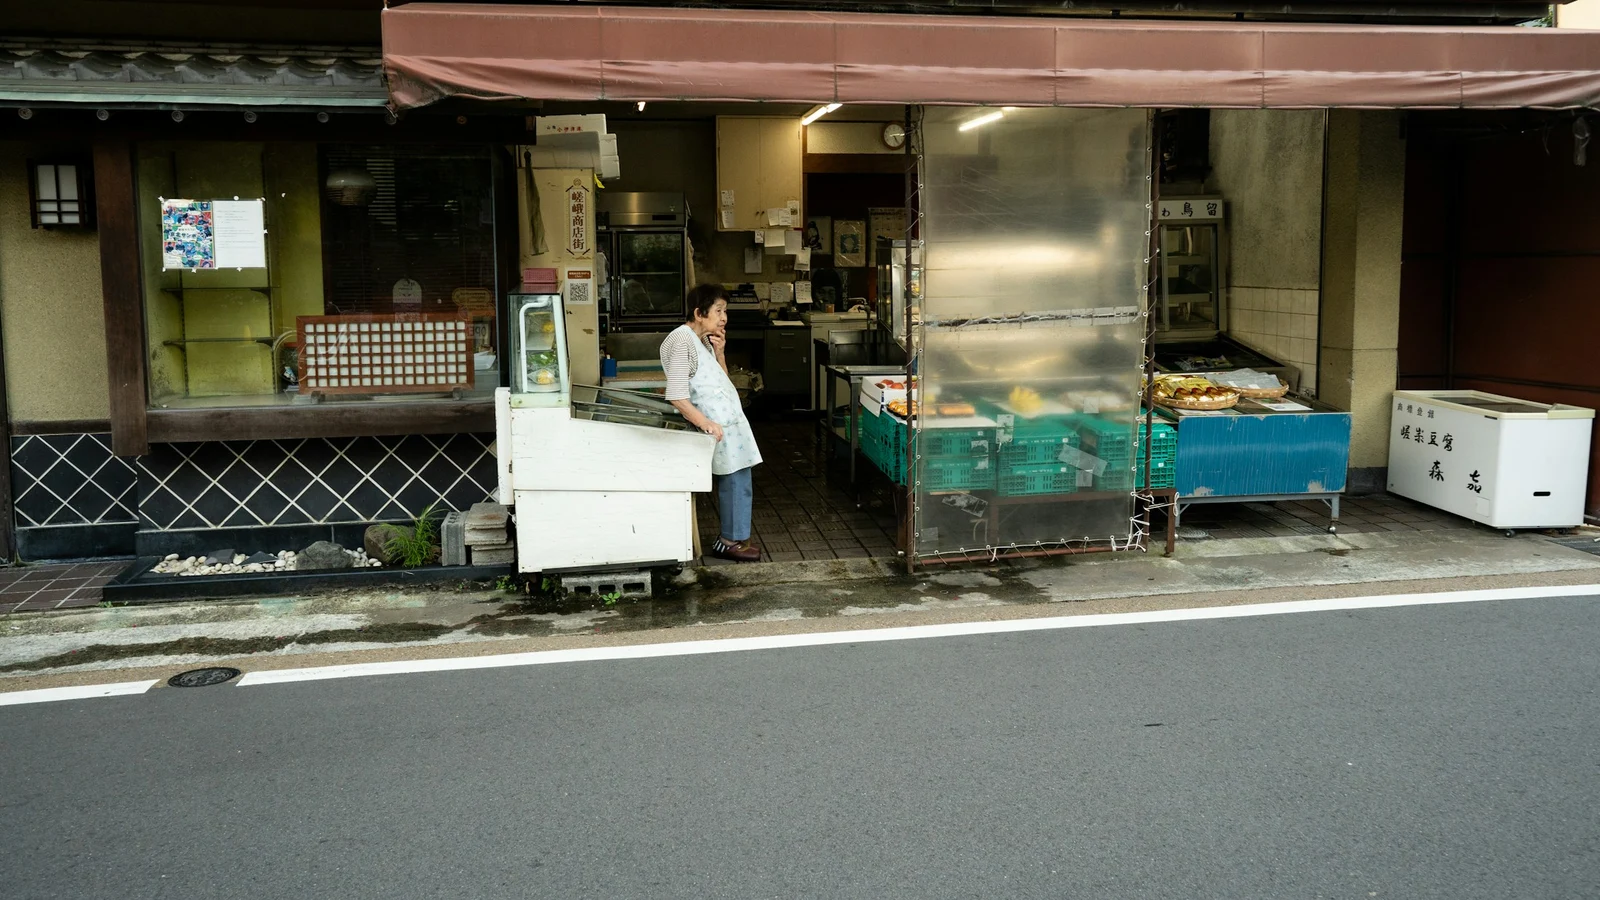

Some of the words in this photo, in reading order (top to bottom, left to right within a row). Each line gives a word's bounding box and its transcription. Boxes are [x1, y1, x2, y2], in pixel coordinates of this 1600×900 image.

[571, 191, 585, 250] 嵯峨商店街
